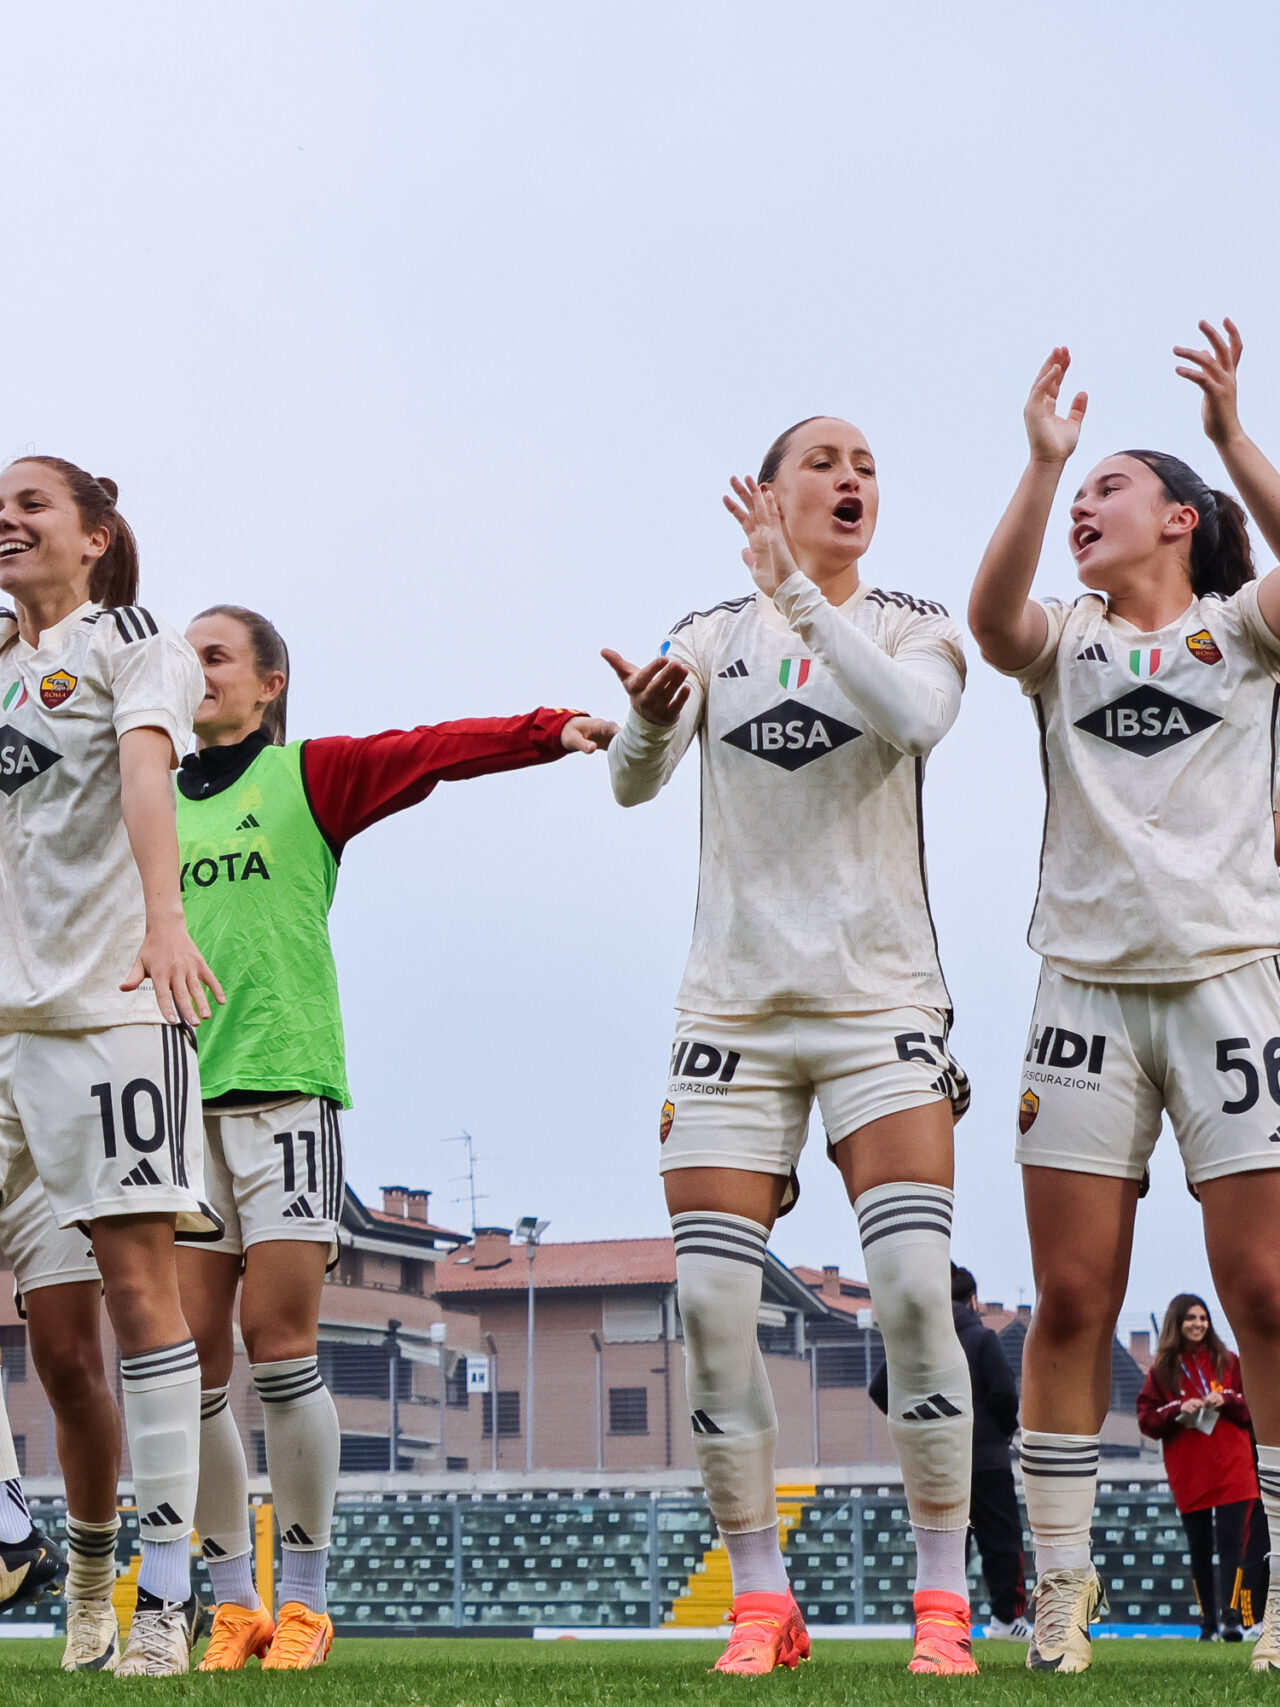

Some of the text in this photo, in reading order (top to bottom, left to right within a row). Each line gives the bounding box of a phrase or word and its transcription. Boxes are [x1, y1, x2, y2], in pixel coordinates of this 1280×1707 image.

[750, 720, 832, 750] IBSA
[1105, 707, 1191, 737] IBSA
[1026, 1024, 1106, 1074] HDI
[91, 1078, 165, 1158] 10
[274, 1131, 317, 1193] 11
